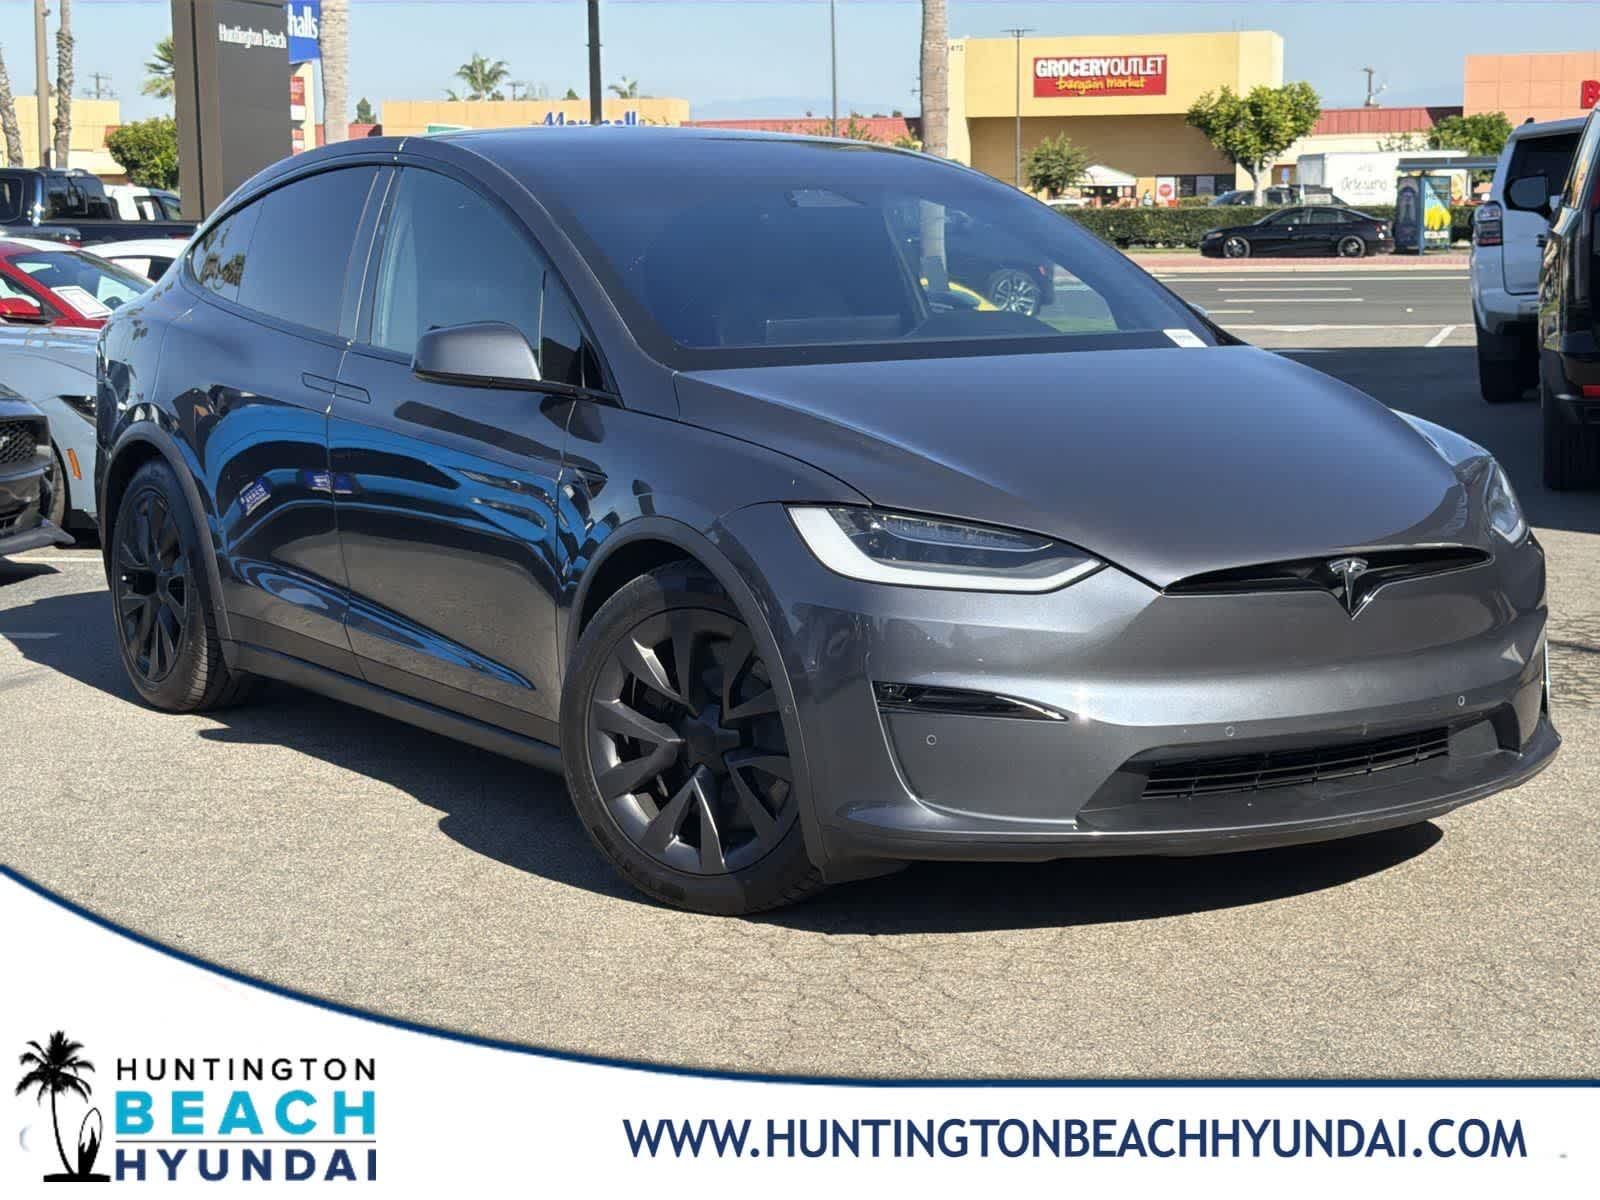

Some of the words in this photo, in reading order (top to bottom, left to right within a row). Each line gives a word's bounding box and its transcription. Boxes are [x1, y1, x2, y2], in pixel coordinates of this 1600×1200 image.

[219, 23, 262, 48] Huntington
[262, 28, 287, 48] Beach
[1056, 77, 1105, 95] bargain
